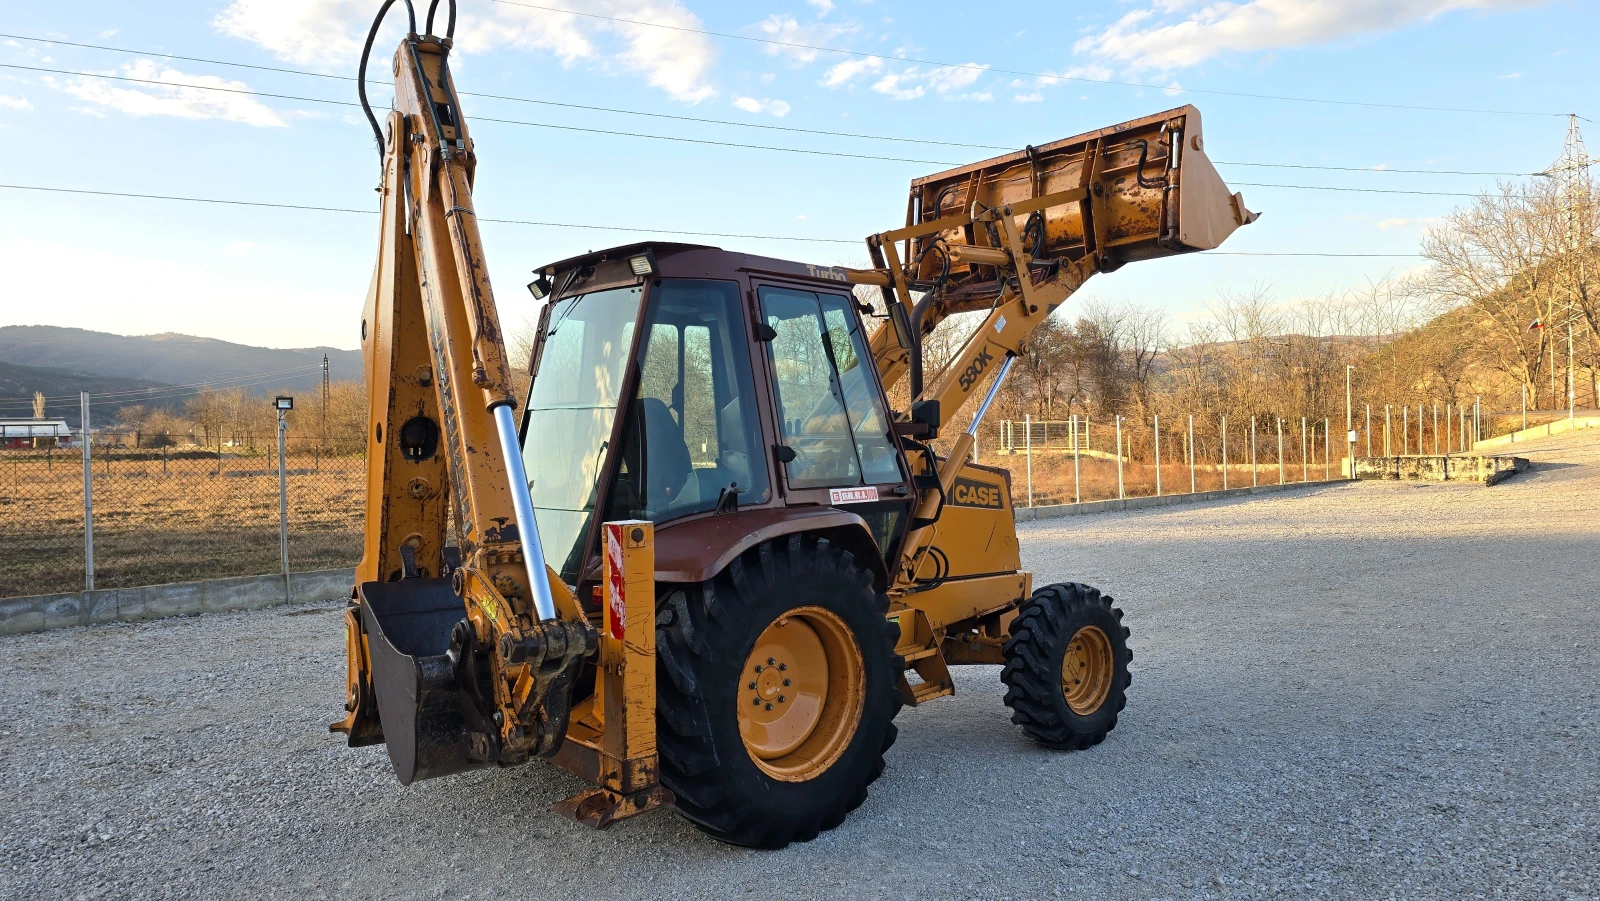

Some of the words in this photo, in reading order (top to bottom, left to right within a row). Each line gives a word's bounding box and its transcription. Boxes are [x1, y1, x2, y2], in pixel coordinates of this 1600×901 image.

[806, 264, 847, 281] Turbo
[958, 345, 994, 392] 580K
[955, 485, 999, 506] CASE
